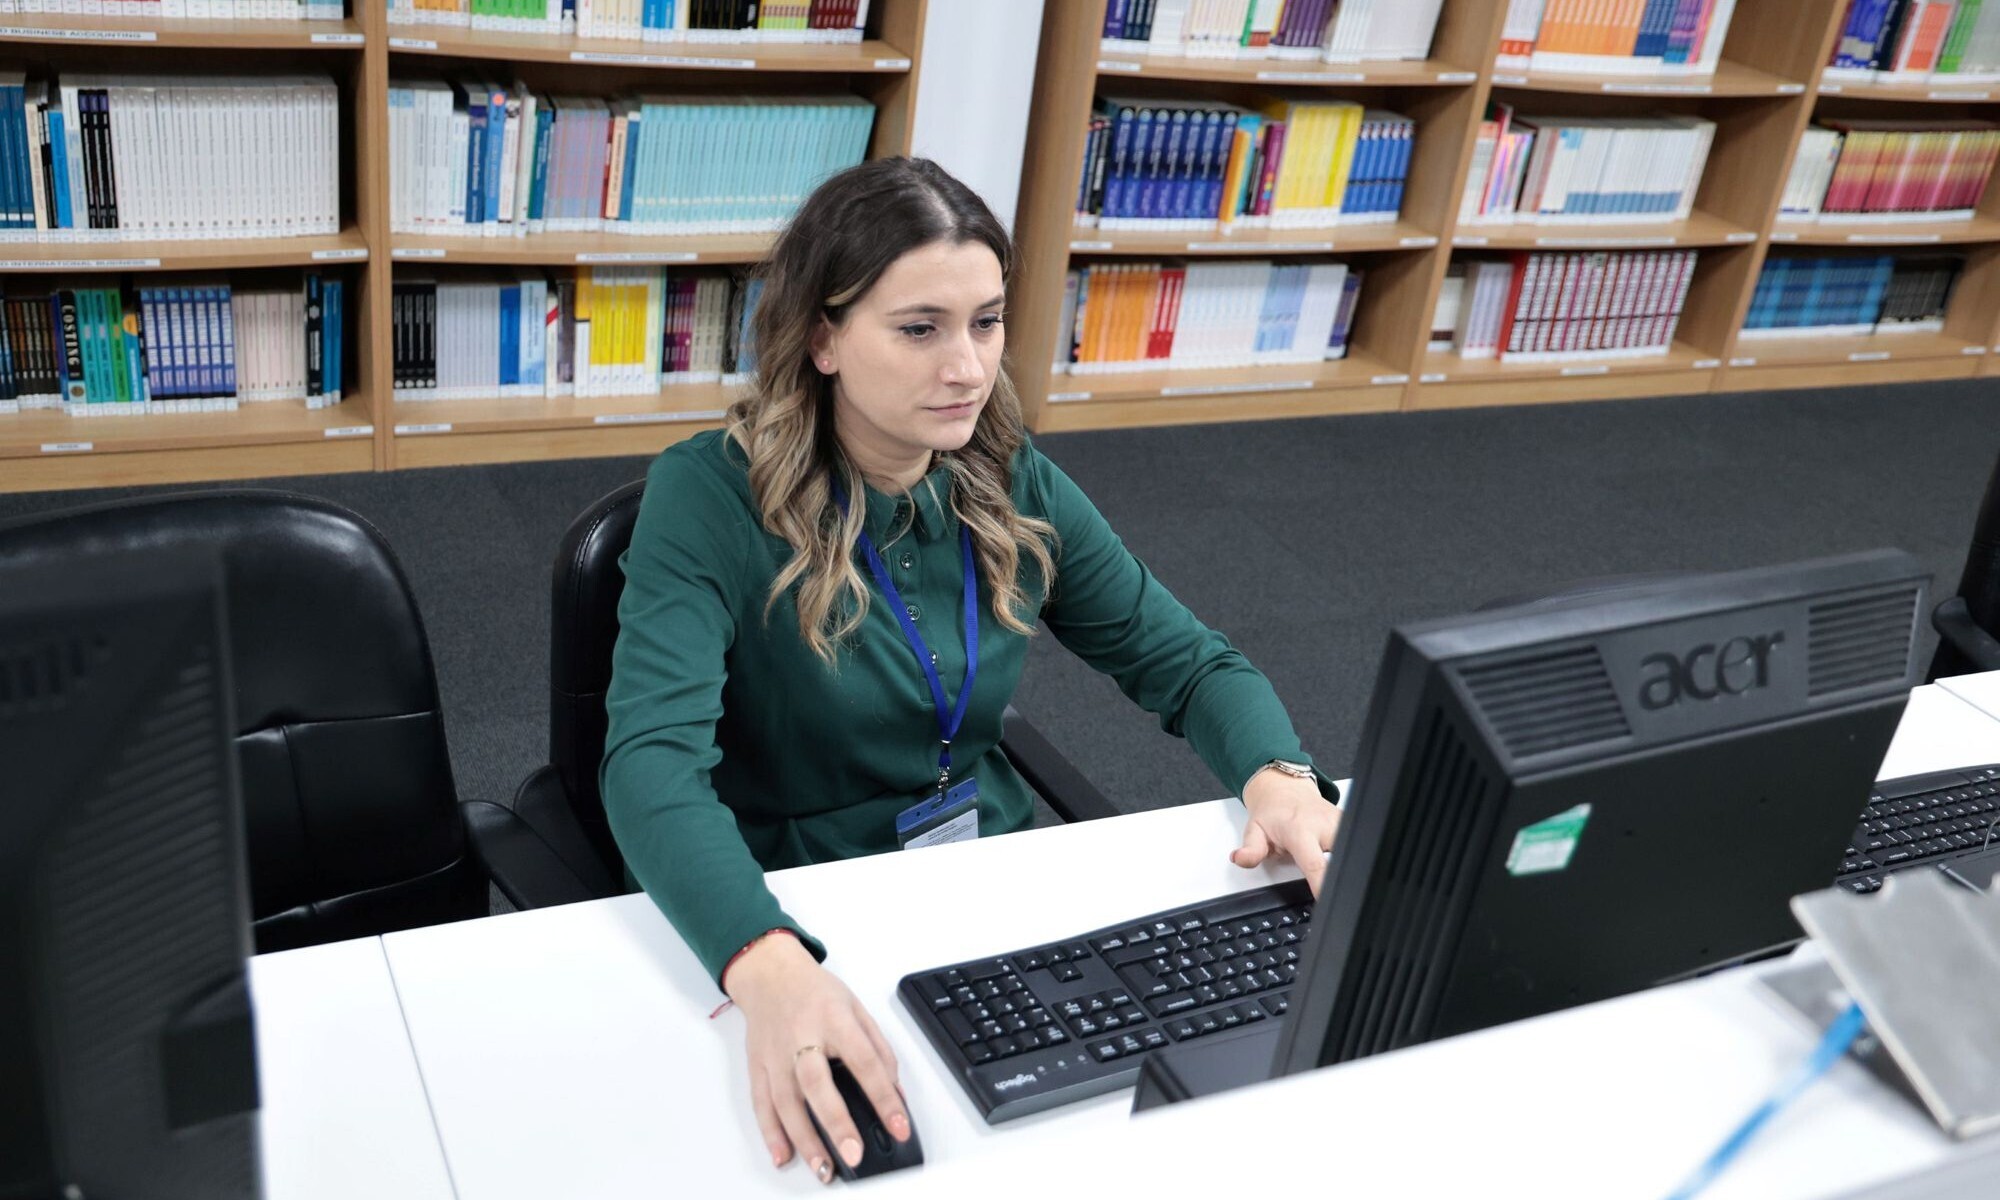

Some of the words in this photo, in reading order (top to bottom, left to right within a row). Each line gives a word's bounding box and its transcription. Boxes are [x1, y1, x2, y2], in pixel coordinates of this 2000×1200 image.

[62, 305, 80, 366] COSTING
[1638, 629, 1785, 713] acer
[993, 1073, 1037, 1091] logitech
